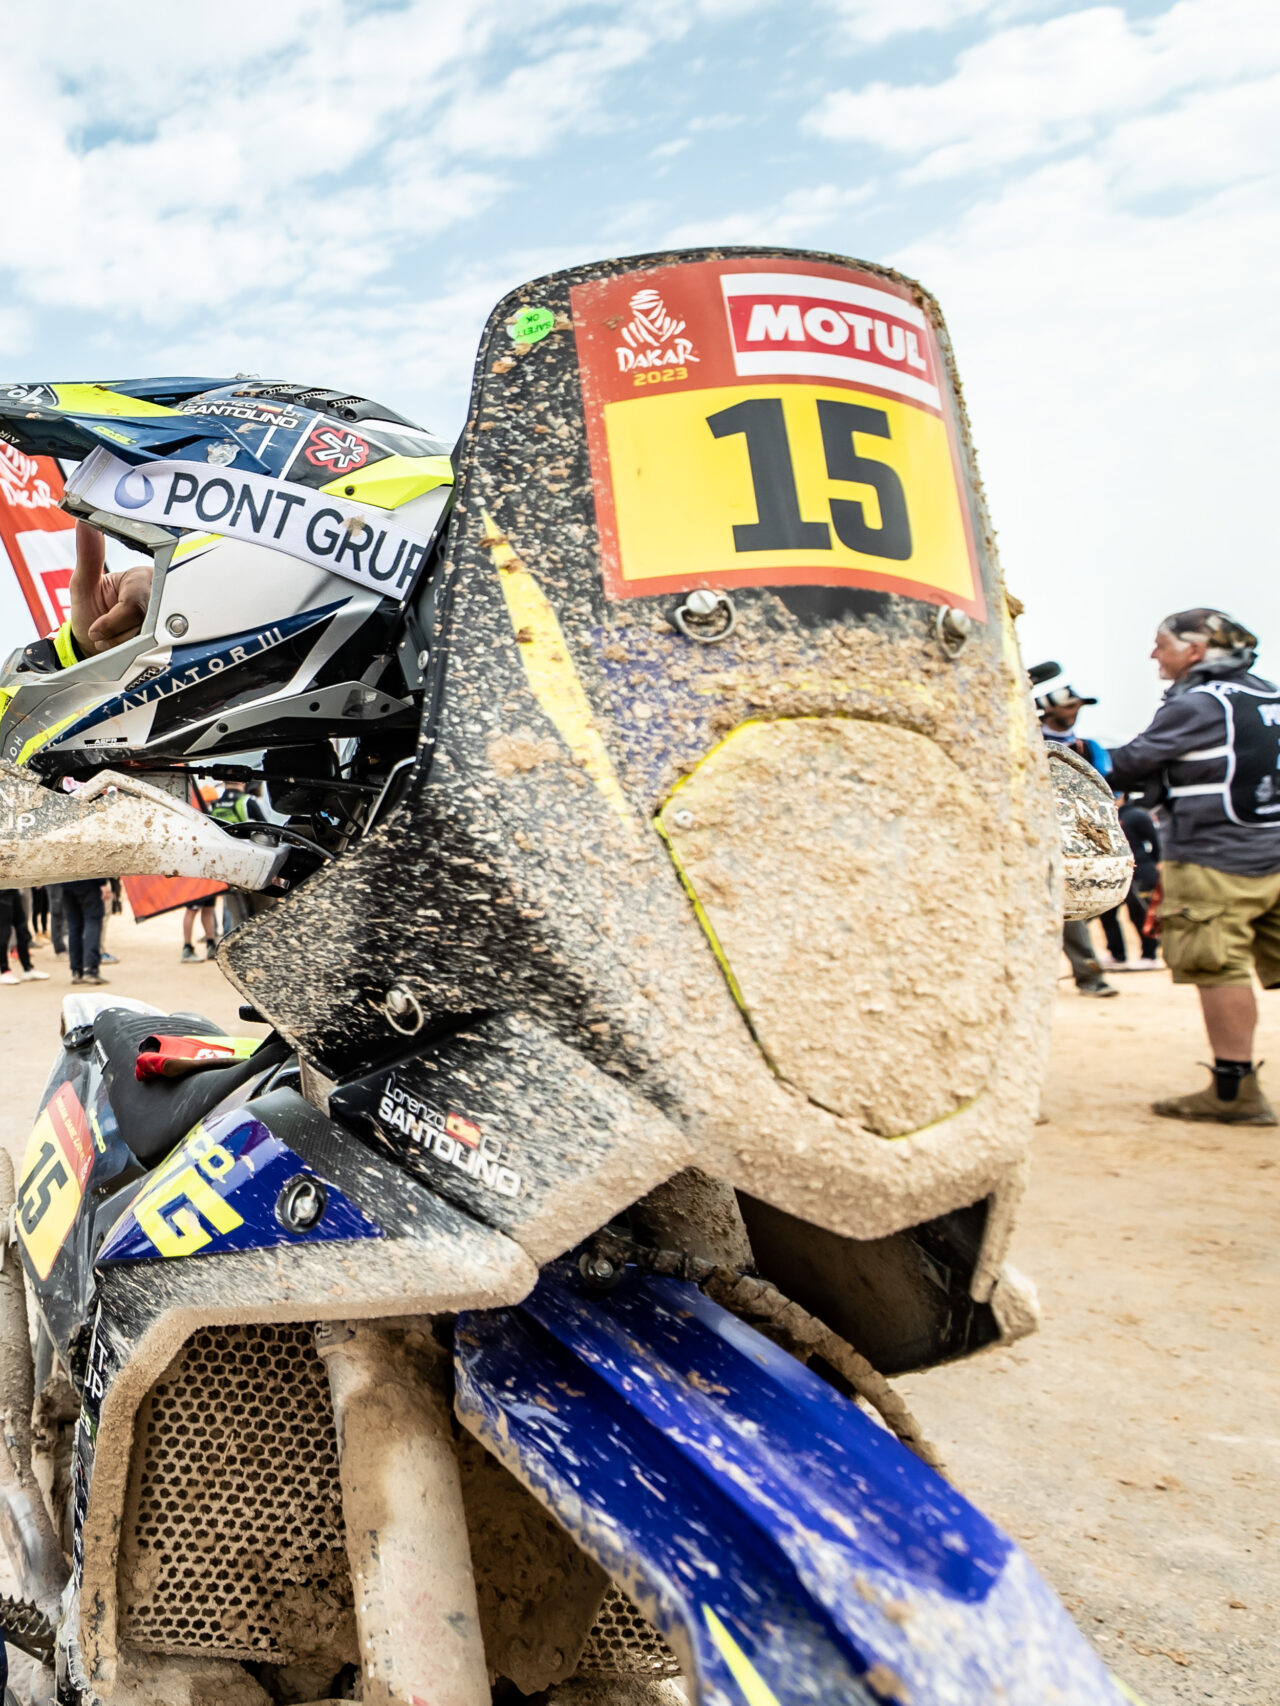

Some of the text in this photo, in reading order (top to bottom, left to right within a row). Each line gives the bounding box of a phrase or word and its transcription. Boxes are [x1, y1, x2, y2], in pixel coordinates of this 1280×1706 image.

[615, 338, 701, 372] DAKAR
[746, 304, 927, 373] MOTUL
[633, 367, 689, 387] 2023
[163, 471, 307, 541] PONT
[706, 397, 914, 562] 15
[122, 645, 249, 714] AVIATOR
[384, 1077, 446, 1132] Lorenzo
[377, 1096, 522, 1198] SANTOLINO
[17, 1141, 69, 1236] 15
